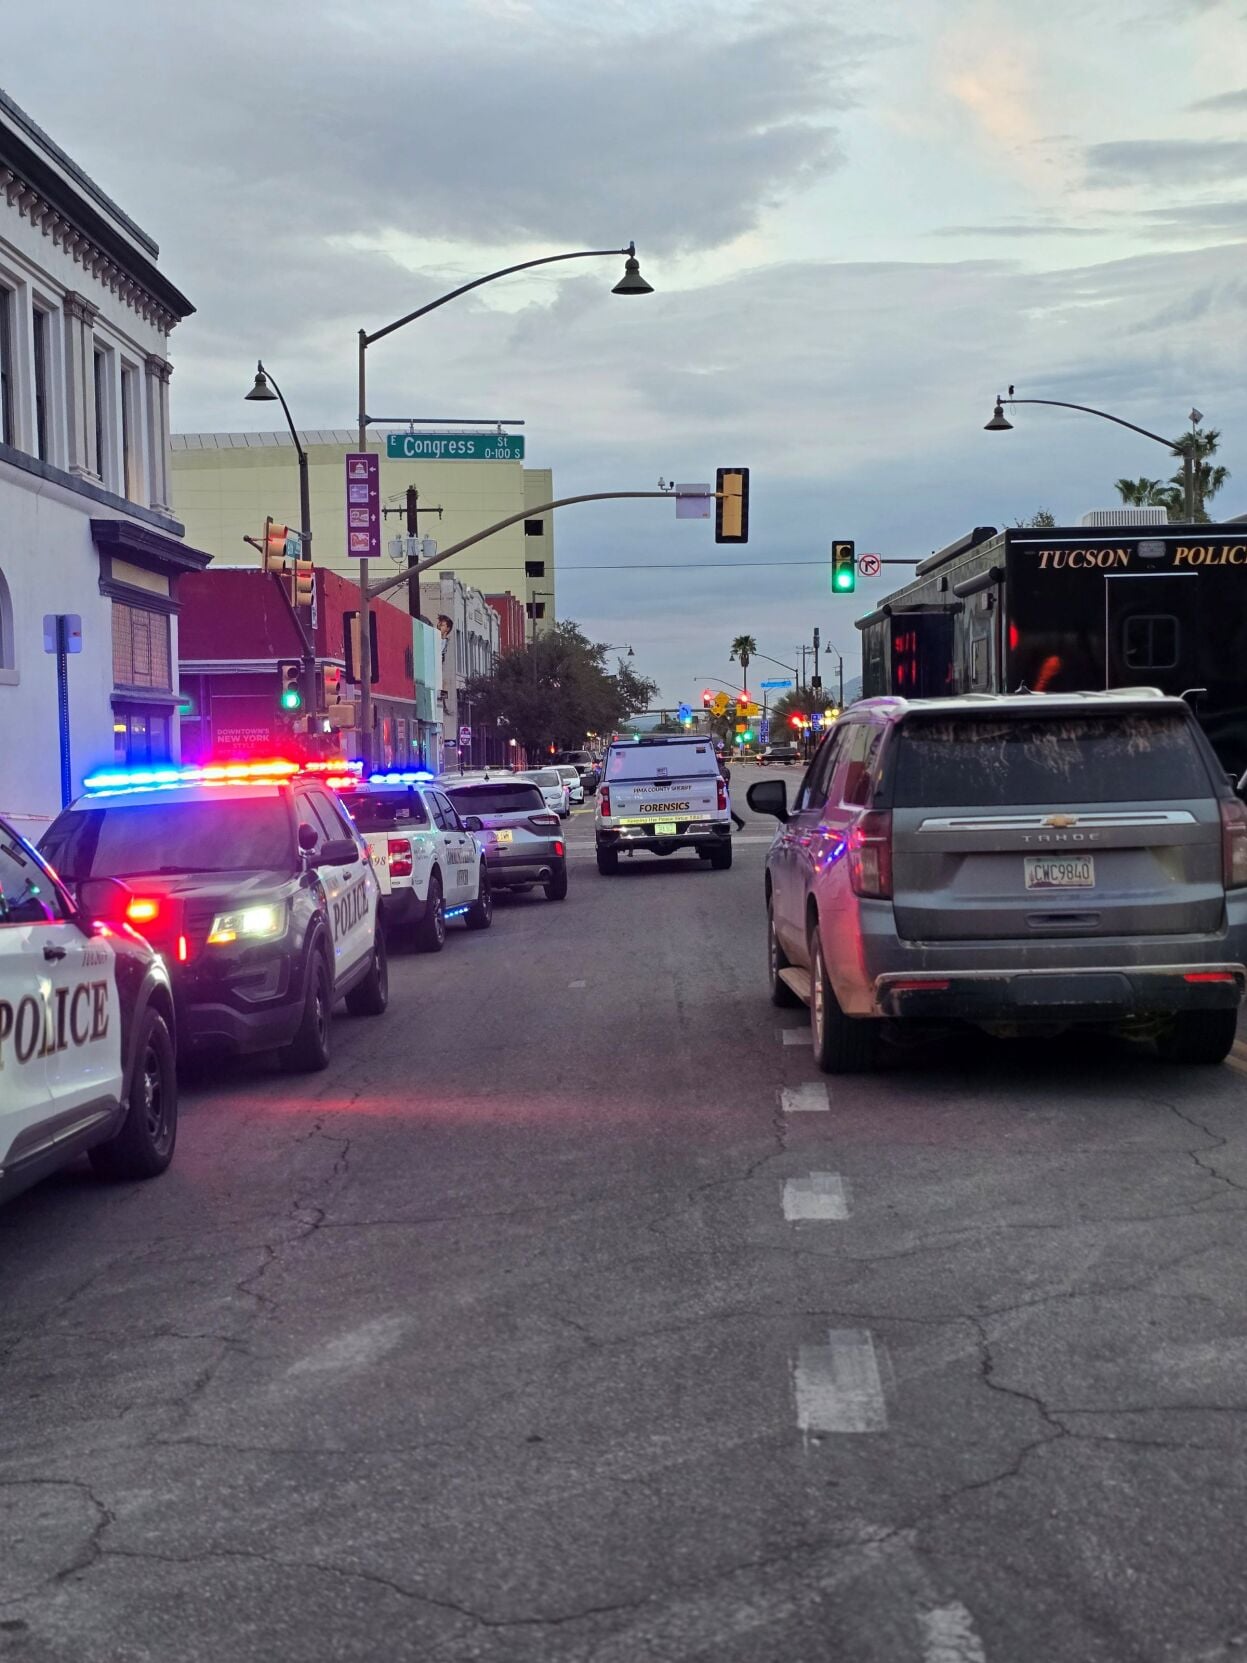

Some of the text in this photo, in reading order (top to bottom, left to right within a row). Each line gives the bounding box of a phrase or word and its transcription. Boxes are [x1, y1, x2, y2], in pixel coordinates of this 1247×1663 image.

[391, 436, 508, 458] E Congress St
[484, 448, 521, 459] 0-100 S
[1038, 545, 1247, 569] TUCSON POLIC
[217, 734, 270, 743] NEW YORK
[648, 785, 670, 793] COUNTY
[639, 802, 690, 813] FORENSICS
[1021, 833, 1100, 842] TAHOE
[1034, 863, 1090, 881] CWC9840
[333, 880, 369, 942] POLICE
[0, 980, 109, 1070] POLICE
